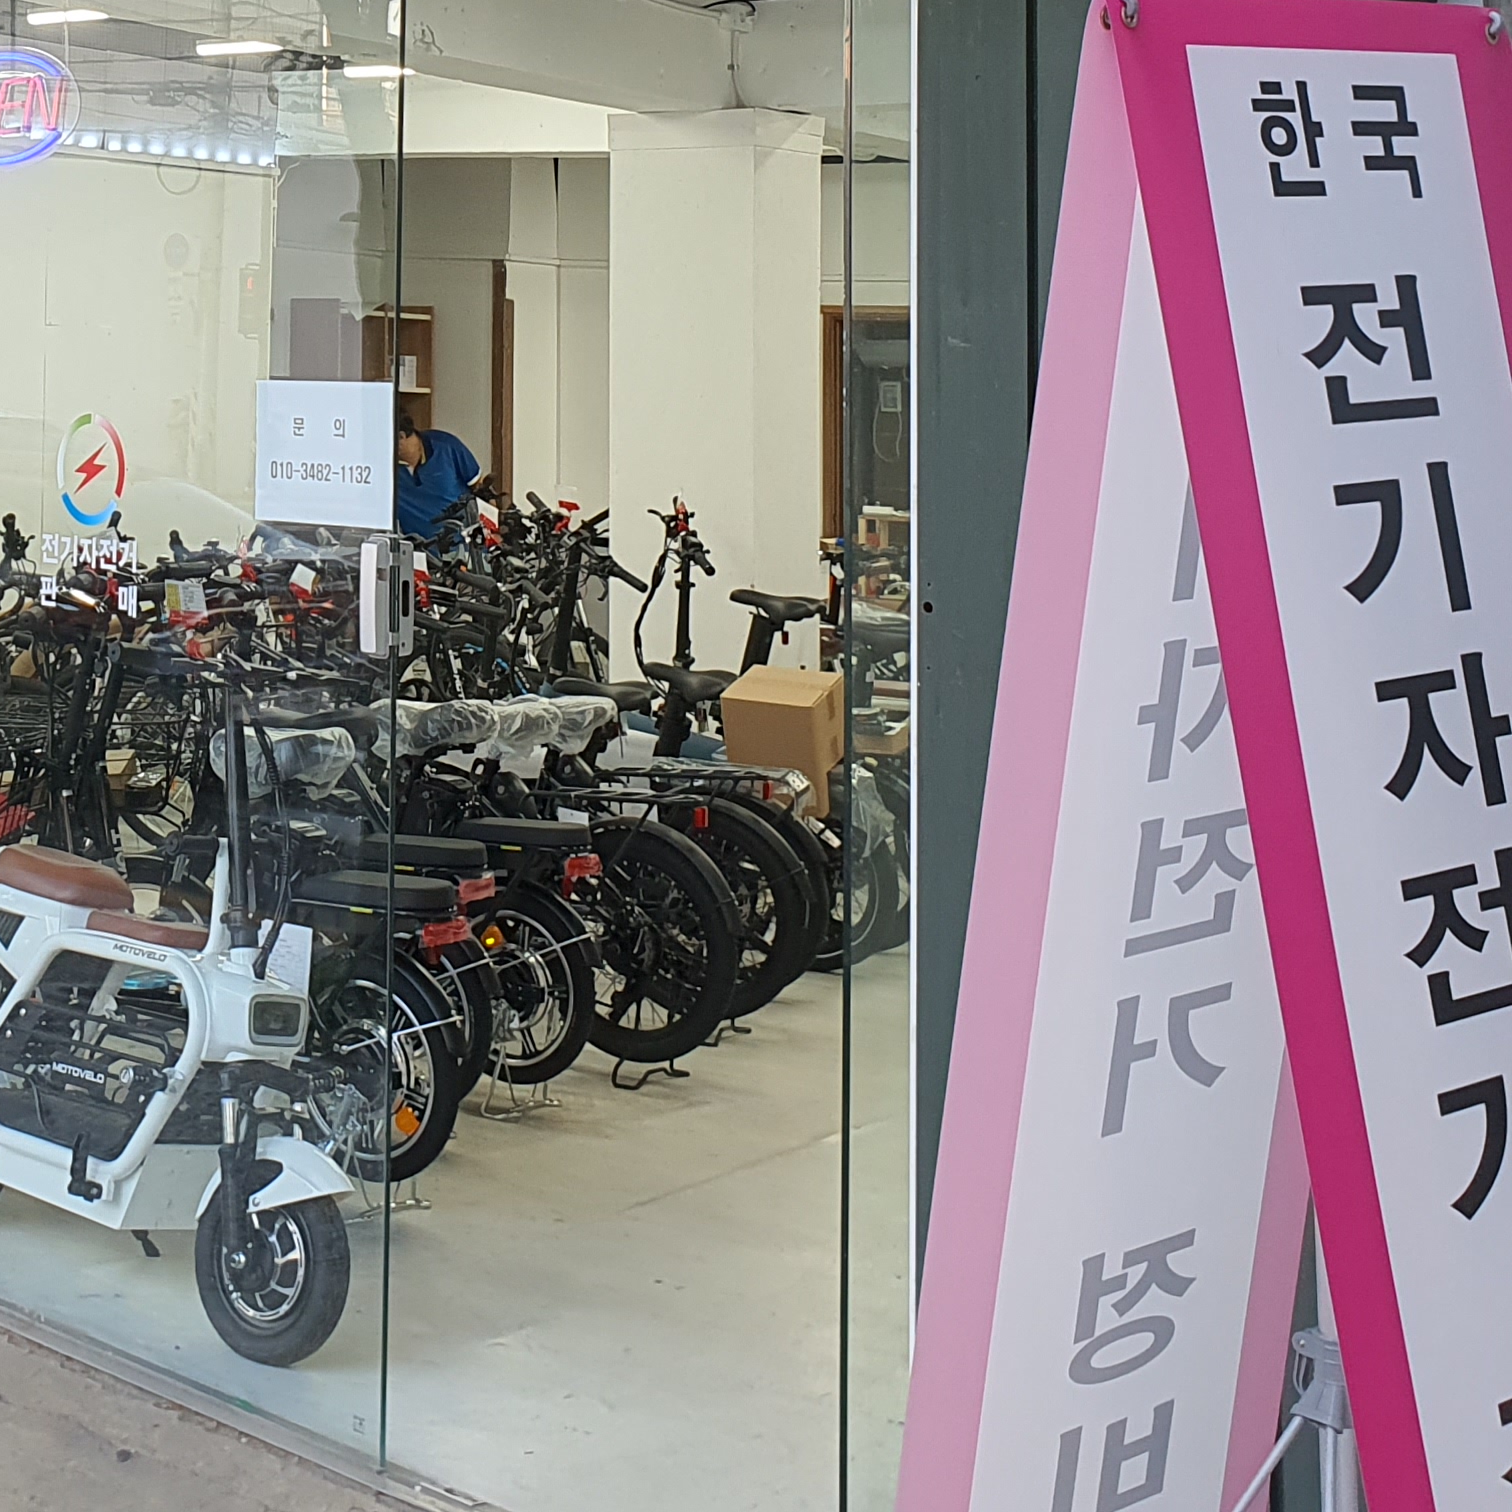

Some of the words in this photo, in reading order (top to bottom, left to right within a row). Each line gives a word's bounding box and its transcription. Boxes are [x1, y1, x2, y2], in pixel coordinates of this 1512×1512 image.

[1250, 78, 1424, 202] 한국
[270, 460, 372, 485] 010-3482-1132
[40, 532, 138, 574] 전기자전거
[112, 942, 169, 963] MOTOVELO
[51, 1060, 106, 1085] MOTOVELO
